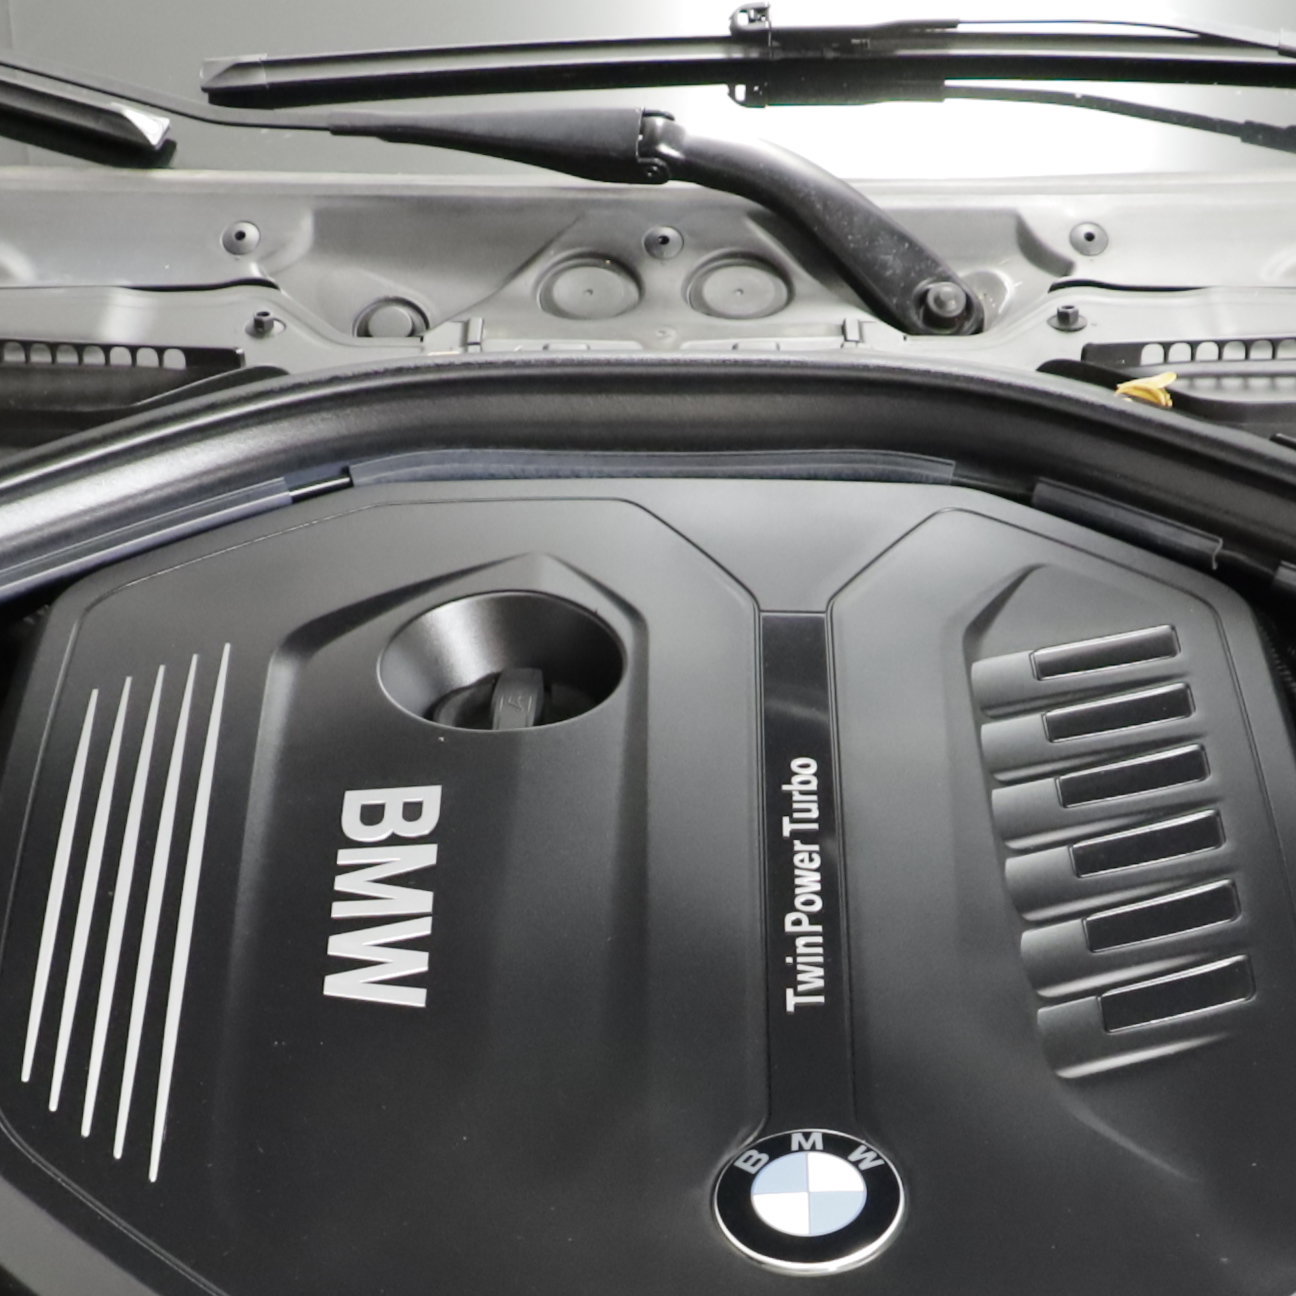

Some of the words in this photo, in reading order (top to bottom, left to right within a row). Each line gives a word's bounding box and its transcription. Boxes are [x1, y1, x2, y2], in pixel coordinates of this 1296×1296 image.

[781, 757, 820, 837] Turbo
[323, 785, 443, 1008] BMW
[784, 839, 825, 1014] TwinPower
[734, 1131, 885, 1175] BMW
